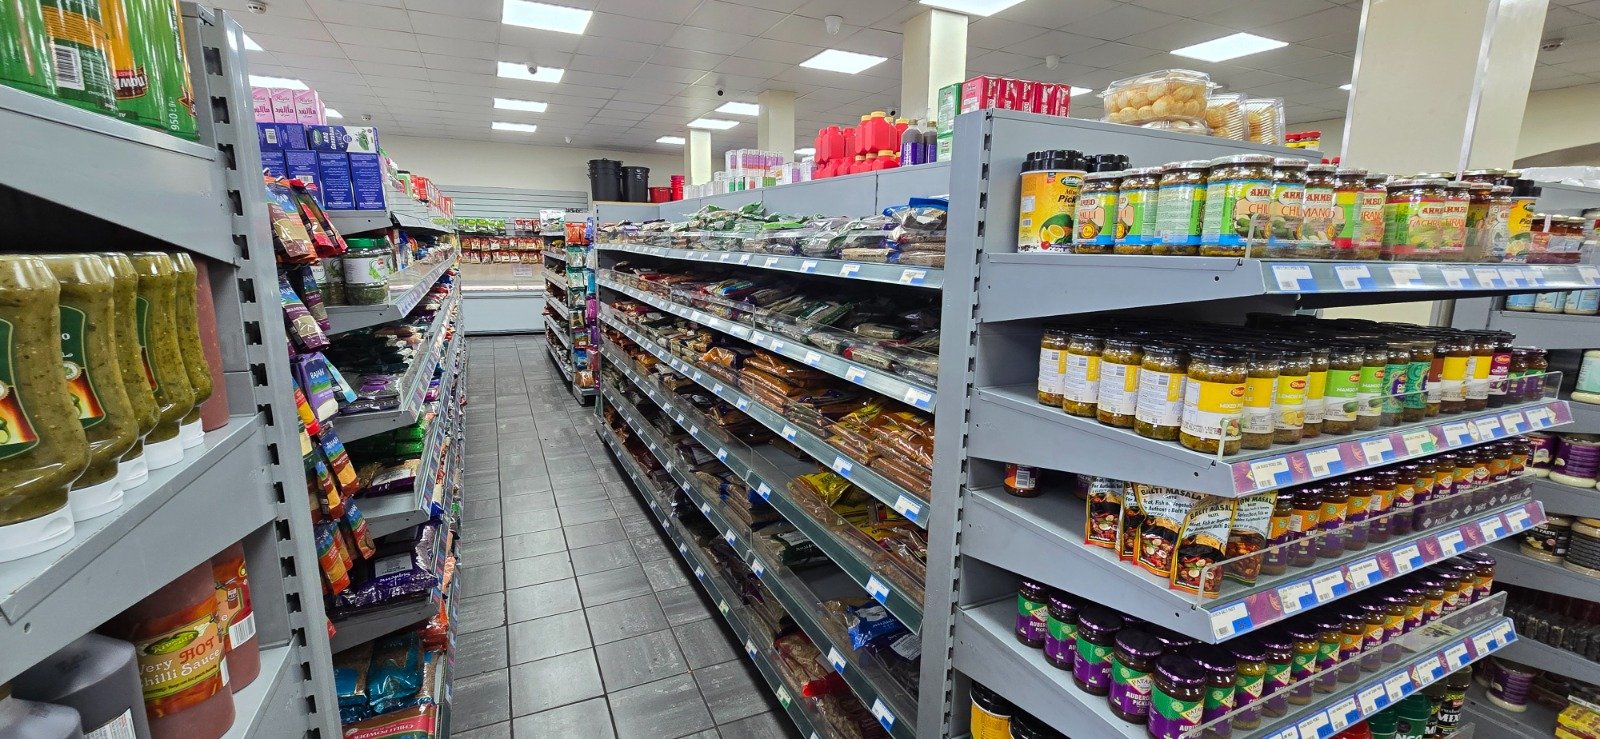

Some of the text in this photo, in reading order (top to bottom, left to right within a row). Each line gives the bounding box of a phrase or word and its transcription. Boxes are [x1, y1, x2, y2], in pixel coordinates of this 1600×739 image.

[1058, 195, 1076, 204] Pick
[1165, 488, 1202, 501] MASALA
[1190, 504, 1232, 520] BALTI MASAL
[179, 636, 217, 664] HOT
[140, 669, 179, 688] hilli
[181, 649, 221, 678] Sauce
[1126, 691, 1149, 701] AUBERG
